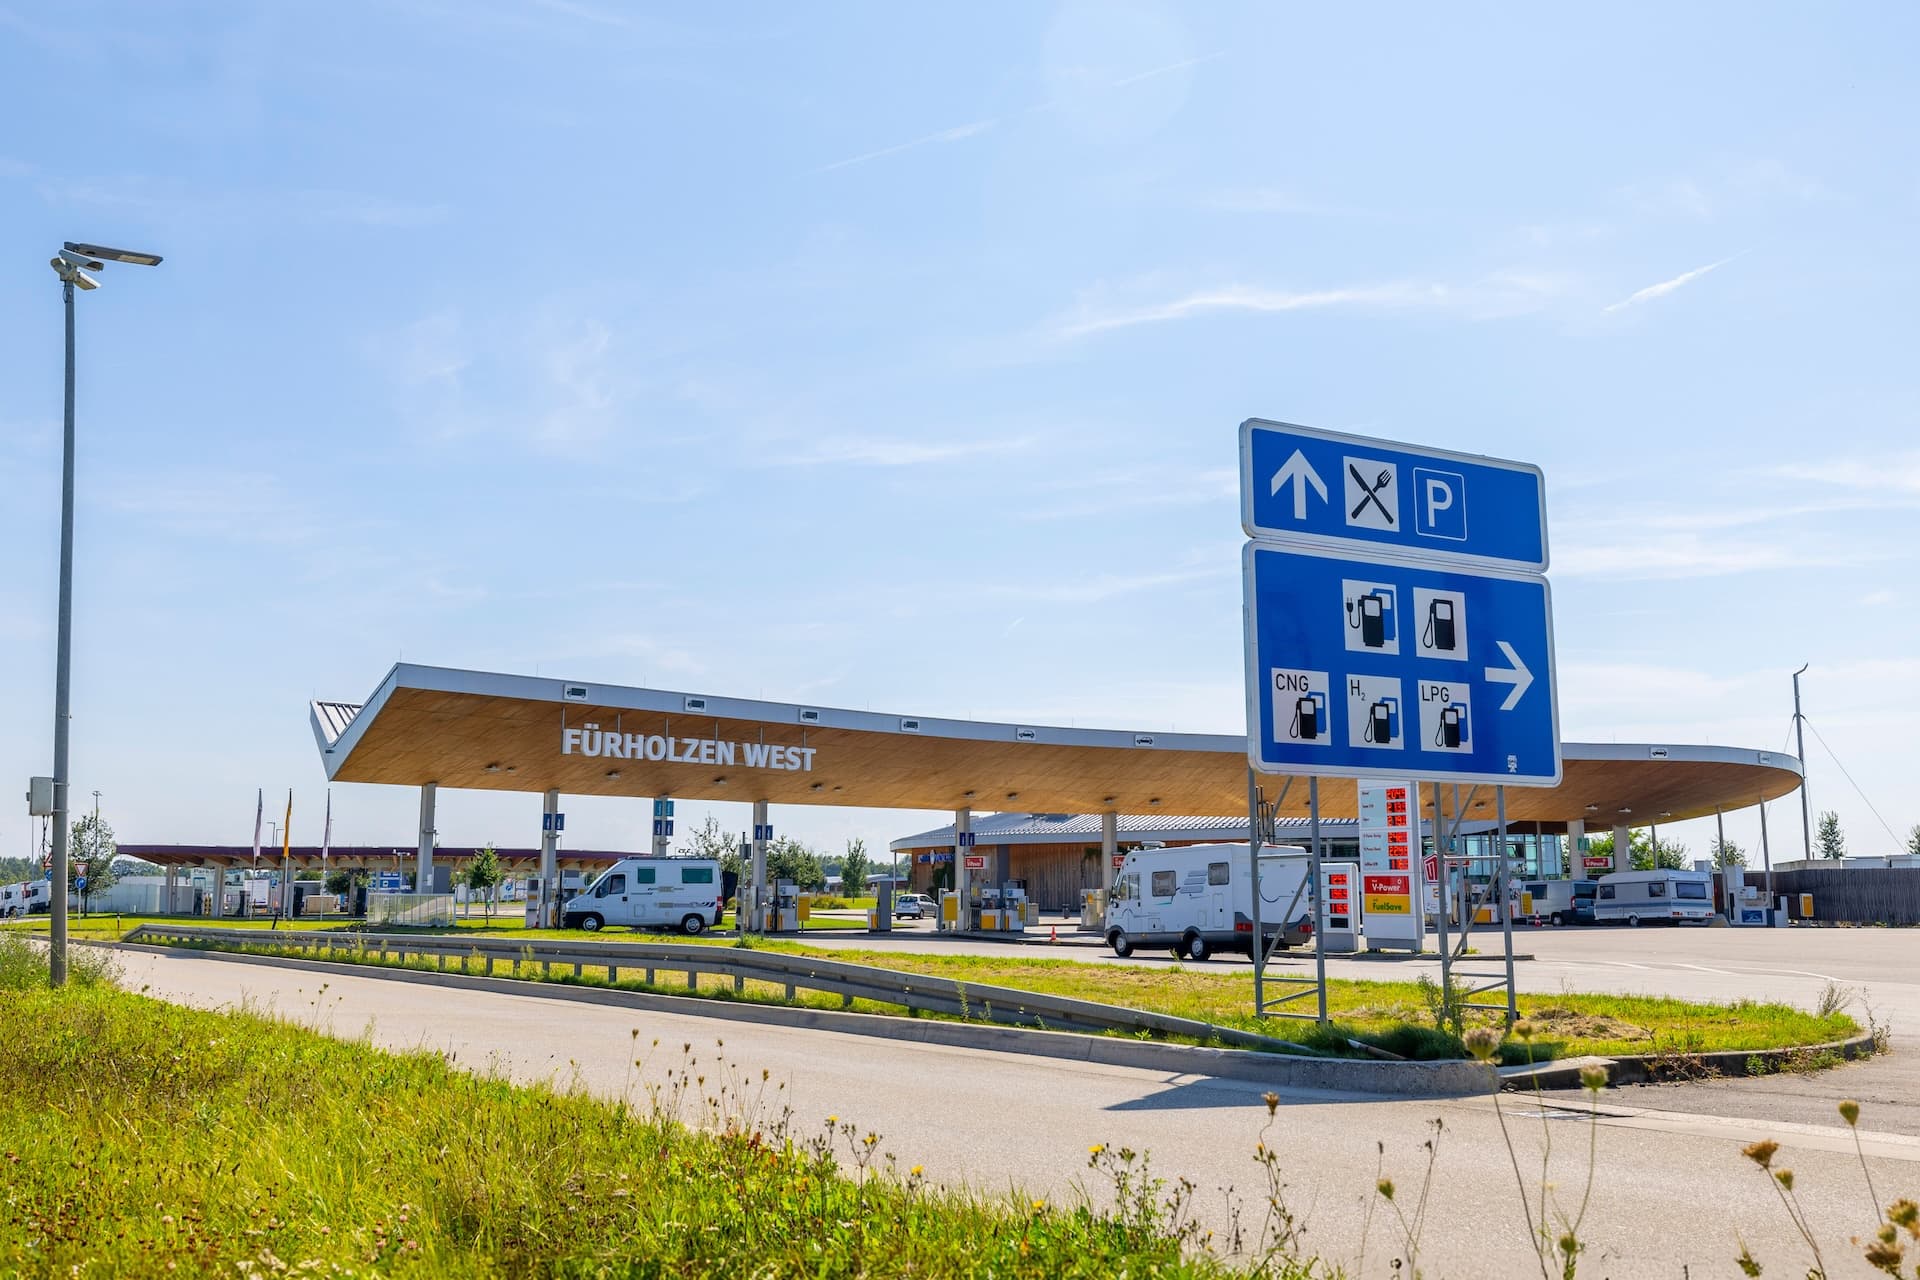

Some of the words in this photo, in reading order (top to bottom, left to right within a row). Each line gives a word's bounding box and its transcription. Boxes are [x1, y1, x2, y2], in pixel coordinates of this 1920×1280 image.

[1426, 479, 1453, 527] P
[1275, 673, 1309, 692] CNG
[1421, 685, 1450, 702] LPG
[562, 723, 735, 766] FÜRHOLZEN
[743, 743, 817, 771] WEST
[1371, 883, 1401, 892] V-Power
[1372, 902, 1402, 911] FuelSave
